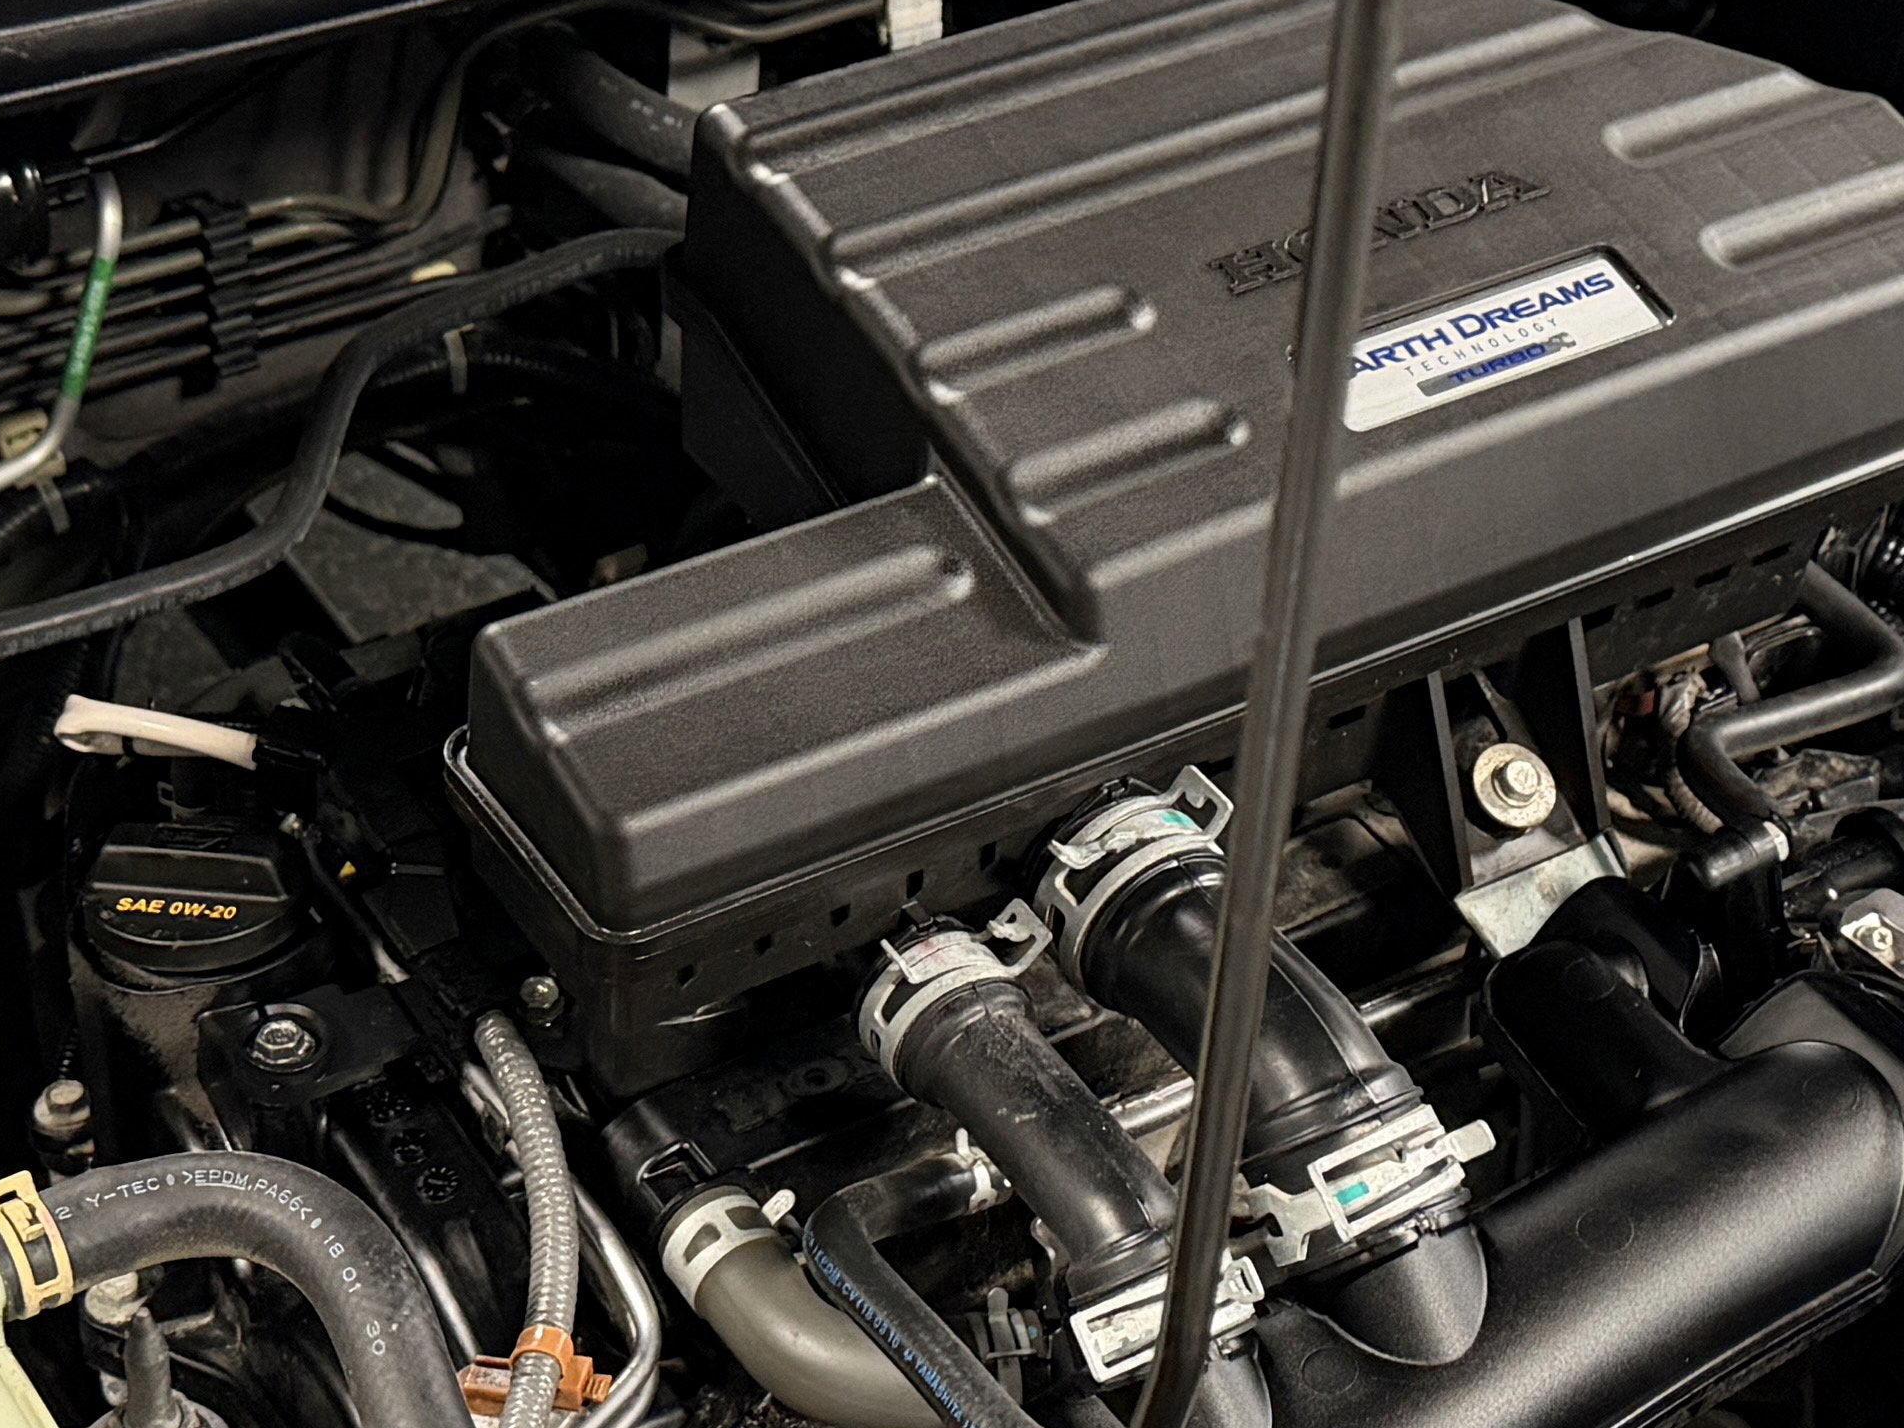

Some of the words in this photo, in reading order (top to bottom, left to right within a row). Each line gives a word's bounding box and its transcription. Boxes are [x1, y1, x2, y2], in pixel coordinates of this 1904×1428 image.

[1350, 328, 1452, 375] ARTH
[1447, 272, 1615, 340] DREAMS
[1405, 318, 1558, 377] TECHNOLOGY
[1448, 344, 1548, 384] TURBO
[116, 897, 166, 914] SAE
[169, 901, 238, 920] 0W-20
[85, 1177, 160, 1208] Y-TEC
[323, 1234, 345, 1259] 18
[342, 1266, 362, 1294] 01
[915, 1357, 964, 1421] YAMASHITA
